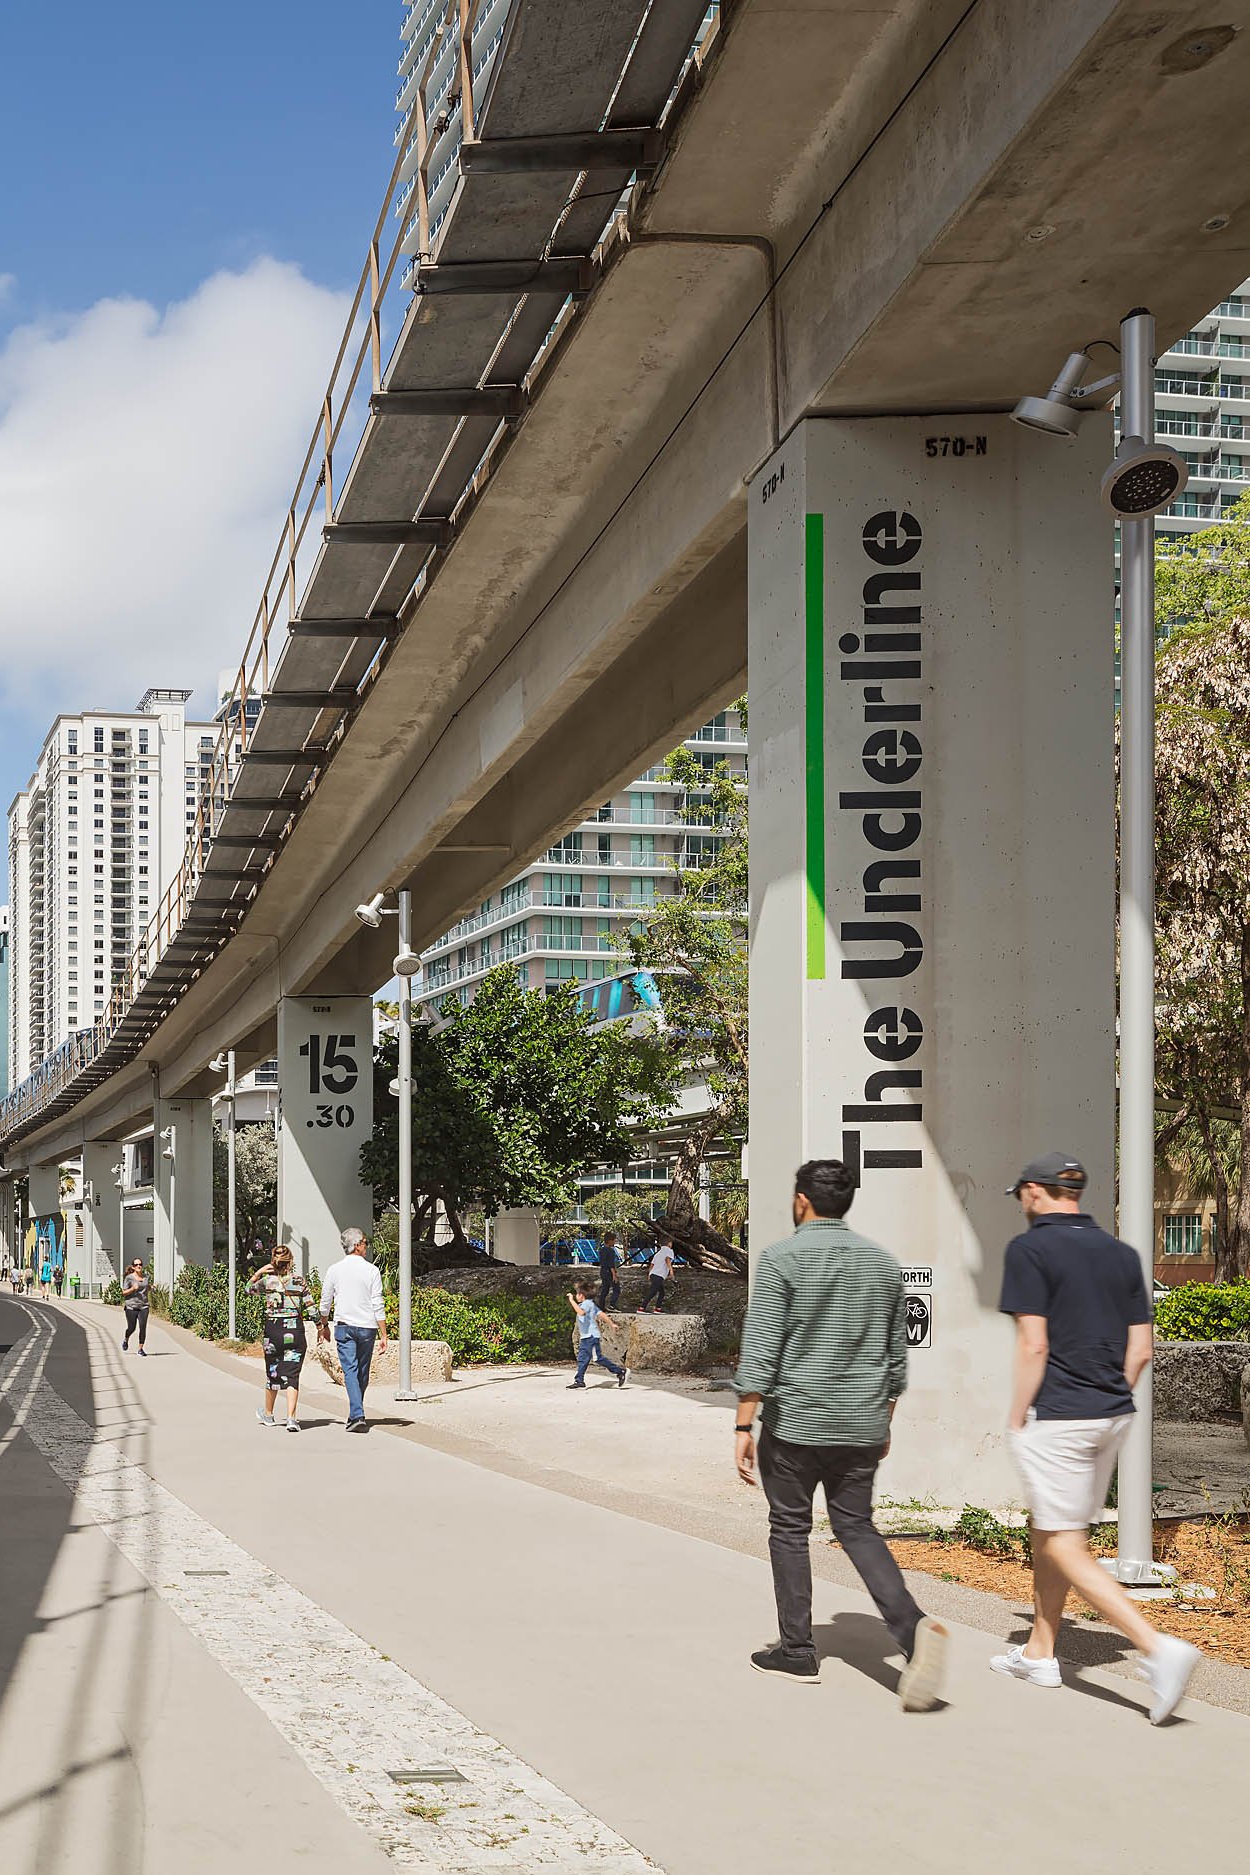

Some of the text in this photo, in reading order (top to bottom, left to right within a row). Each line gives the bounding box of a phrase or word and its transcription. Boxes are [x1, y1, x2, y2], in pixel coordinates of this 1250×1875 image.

[925, 436, 988, 458] 570-N
[762, 462, 785, 504] 570-N
[839, 510, 924, 1188] The Underline
[299, 1034, 359, 1095] 15
[306, 1104, 355, 1129] .30
[900, 1271, 930, 1283] ORTH
